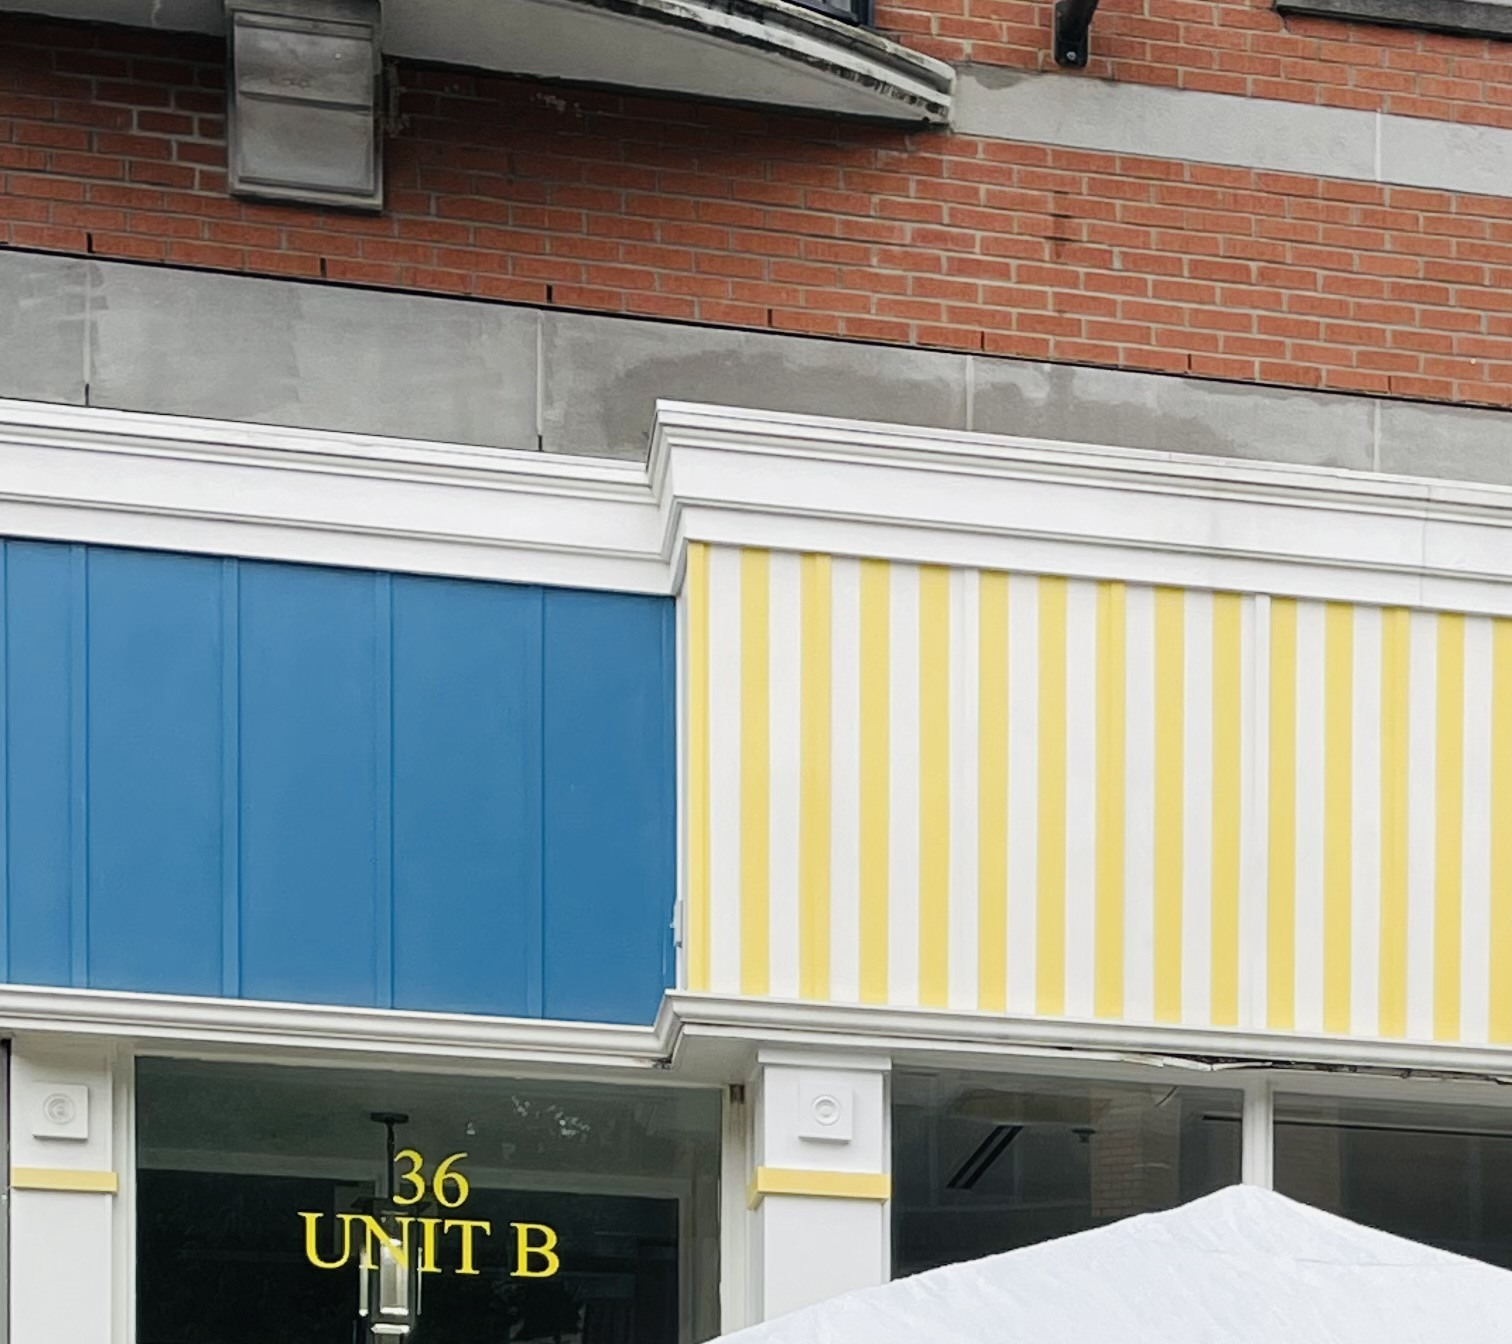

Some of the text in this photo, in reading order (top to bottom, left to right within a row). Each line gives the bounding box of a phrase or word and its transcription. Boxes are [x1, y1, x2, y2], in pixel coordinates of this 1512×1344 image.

[393, 1149, 470, 1208] 36
[297, 1210, 560, 1278] UNIT B
